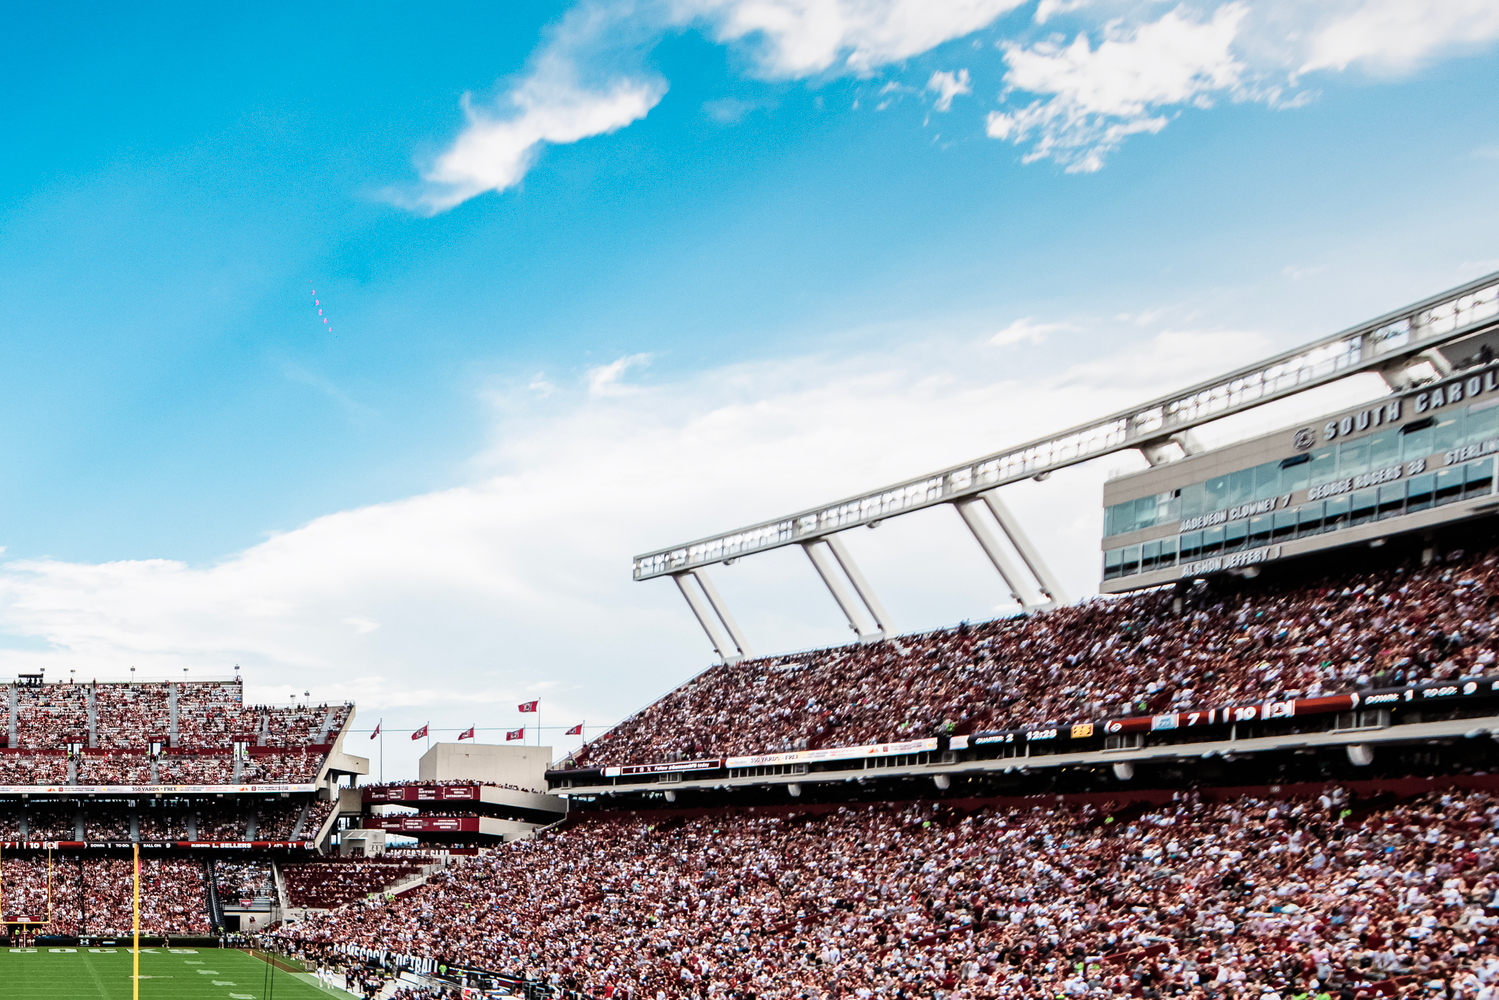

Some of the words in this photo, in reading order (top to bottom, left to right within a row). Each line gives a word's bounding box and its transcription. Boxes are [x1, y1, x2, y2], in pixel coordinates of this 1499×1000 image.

[1324, 401, 1401, 440] SOUTH
[1179, 509, 1229, 533] JADEVEON
[1230, 497, 1278, 521] CLOWNEY
[1282, 494, 1292, 508] 7
[1181, 557, 1223, 578] ALSHON
[1223, 548, 1271, 570] JEFFERY
[1403, 689, 1414, 702] 1
[1463, 682, 1477, 695] 9
[1187, 712, 1200, 726] 7
[1234, 706, 1257, 721] 10
[1005, 733, 1014, 743] 2
[1026, 729, 1057, 741] 12:28
[333, 943, 388, 969] GAMECOCK
